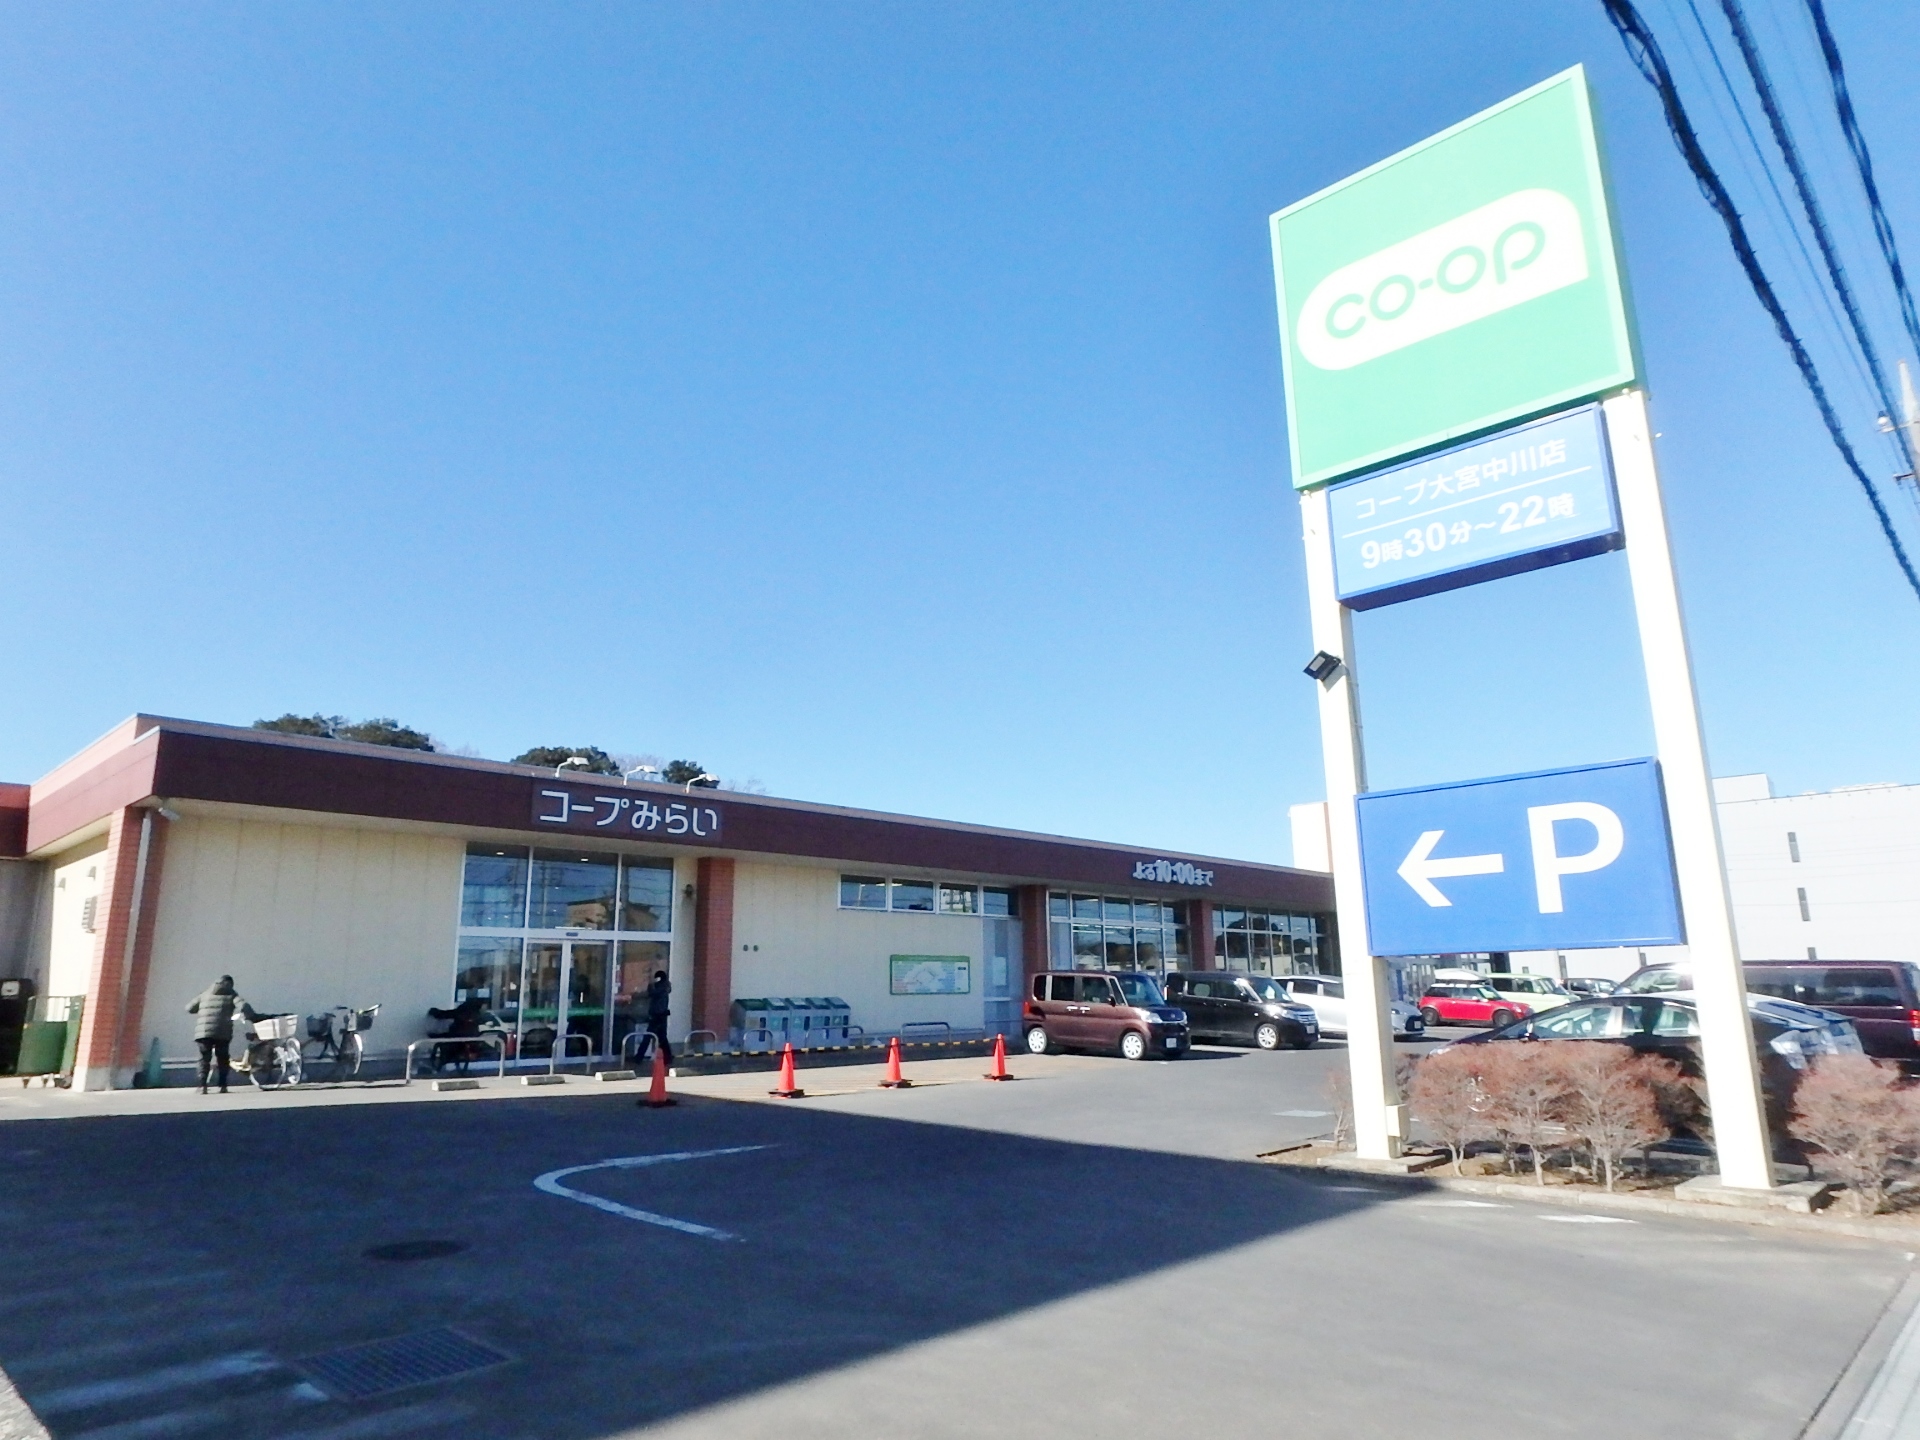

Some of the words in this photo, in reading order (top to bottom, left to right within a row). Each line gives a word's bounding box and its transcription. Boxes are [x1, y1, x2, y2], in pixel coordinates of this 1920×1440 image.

[1356, 438, 1567, 519] コープ大宮中川店
[539, 790, 718, 837] コープみらい
[1132, 859, 1214, 887] よる10:00まで
[1527, 801, 1624, 914] P
